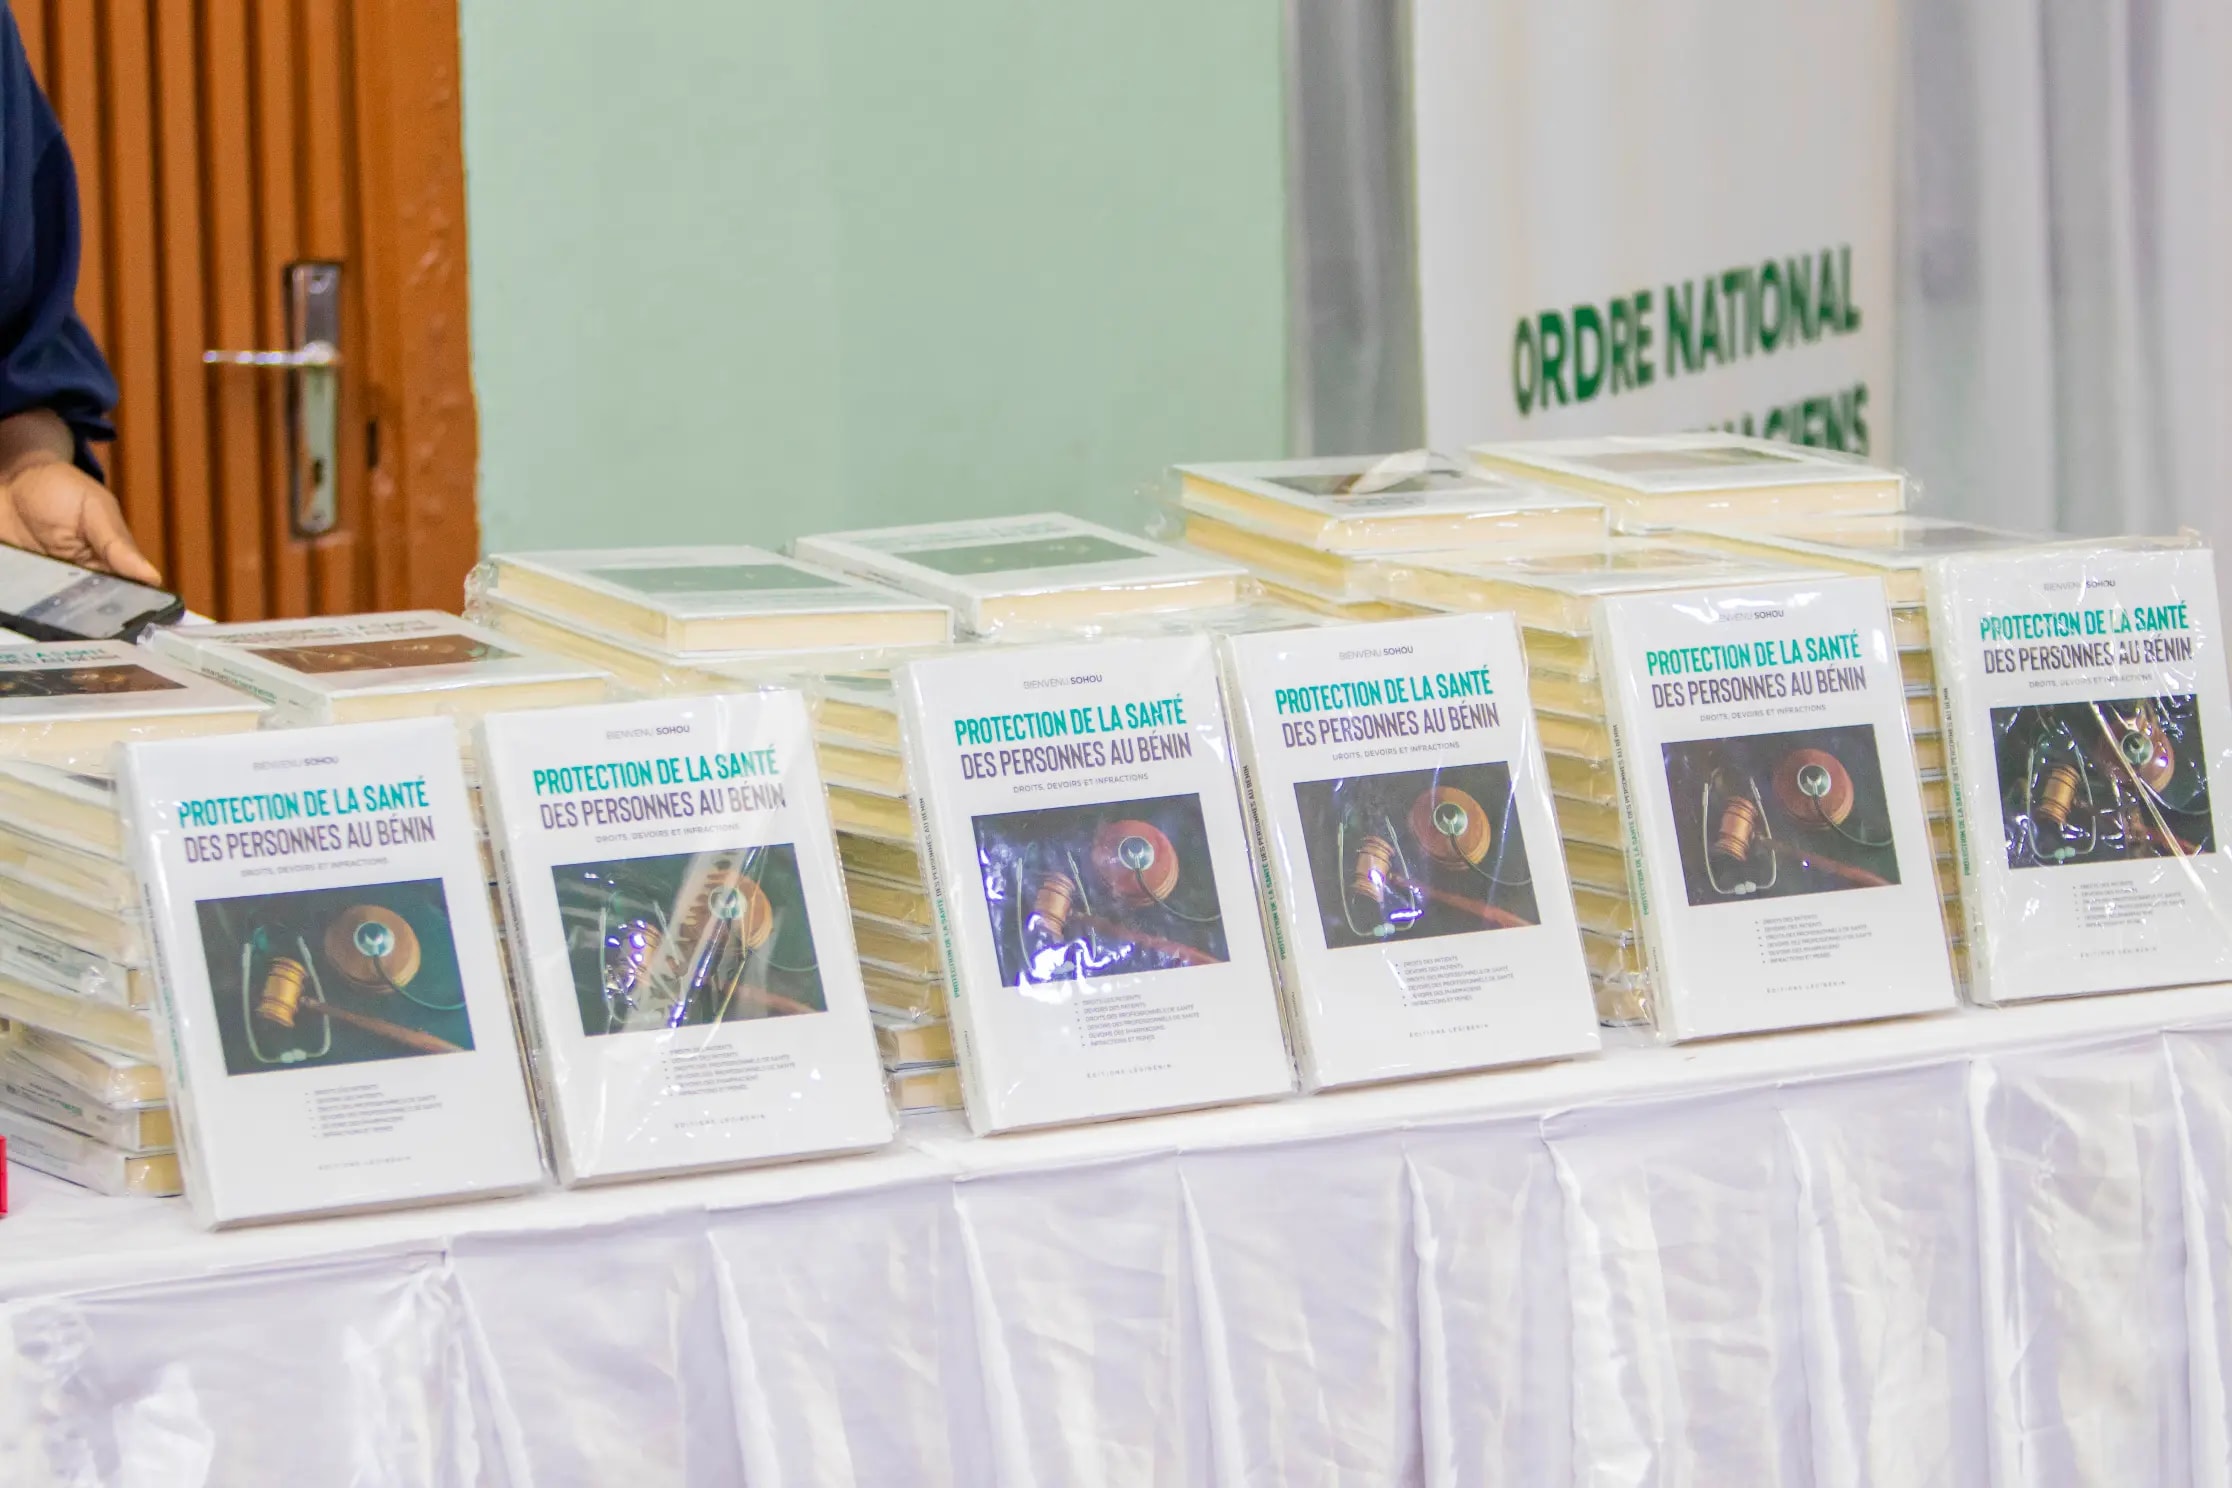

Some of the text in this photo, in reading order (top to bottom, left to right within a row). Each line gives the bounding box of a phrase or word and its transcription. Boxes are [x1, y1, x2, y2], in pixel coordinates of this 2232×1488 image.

[1514, 245, 1863, 416] ORDRE NATIONAL
[2086, 580, 2116, 588] SOHOU
[1754, 610, 1785, 619] SOHOU
[1979, 600, 2189, 641] PROTECTION DE LA SANTÉ
[1383, 646, 1414, 656] SOHOU
[1646, 629, 1862, 676] PROTECTION DE LA SANTÉ
[1983, 634, 2192, 674] DES PERSONNES AU BÉNIN
[1070, 675, 1103, 685] SOHOU
[1275, 665, 1494, 714] PROTECTION DE LA SANTÉ
[1651, 664, 1867, 708] DES PERSONNES AU BÉNIN
[656, 725, 691, 735] SOHOU
[954, 694, 1186, 745] PROTECTION DE LA SANTÉ
[1282, 700, 1500, 747] DES PERSONNES AU BÉNIN
[533, 744, 780, 795] PROTECTION DE LA SANTÉ
[960, 731, 1192, 780] DES PERSONNES AU BÉNIN
[177, 776, 429, 828] PROTECTION DE LA SANTÉ
[539, 781, 786, 829] DES PERSONNES AU BÉNIN
[183, 814, 436, 863] DES PERSONNES AU BÉNIN
